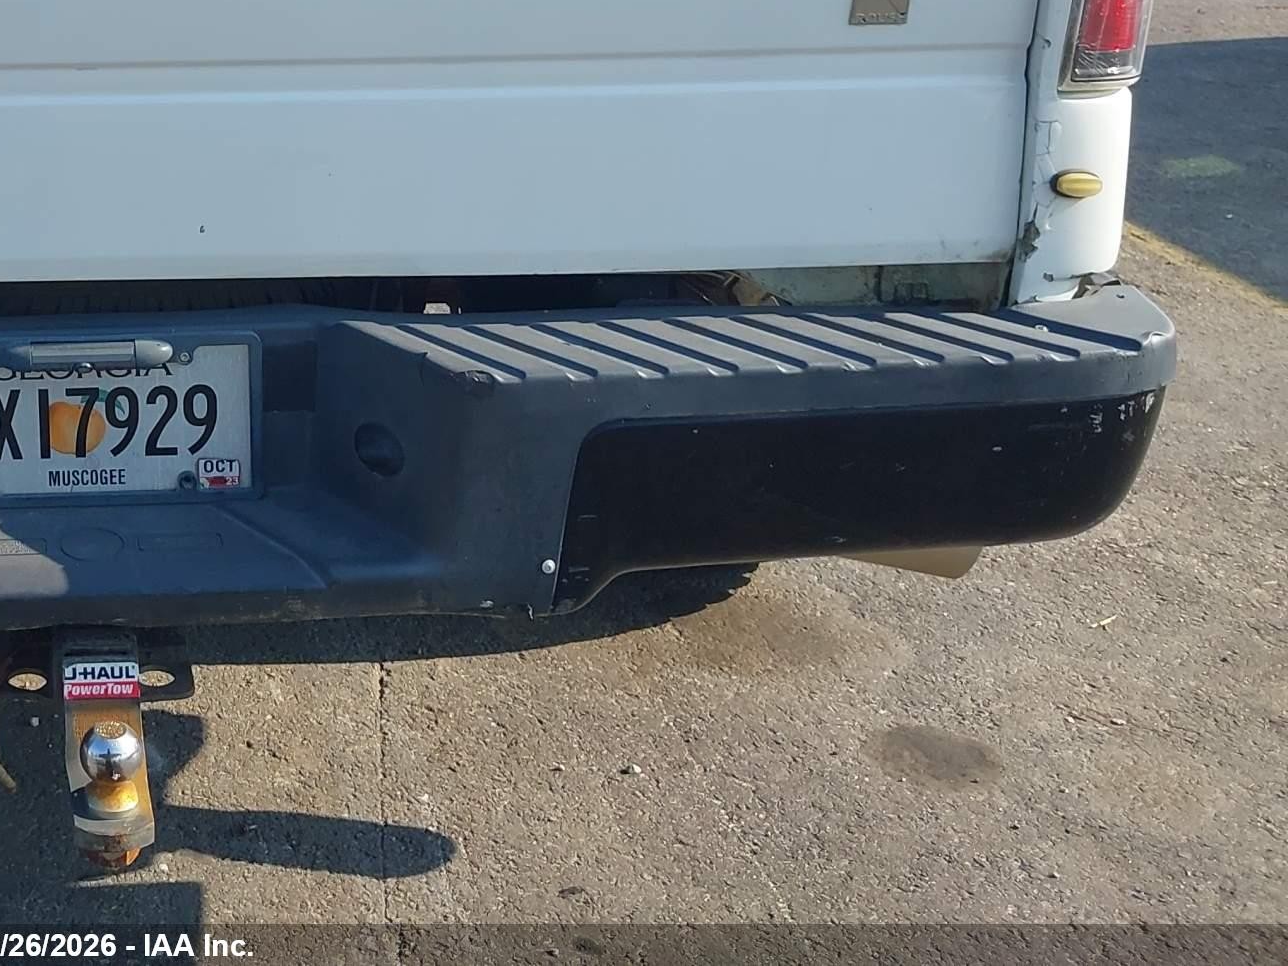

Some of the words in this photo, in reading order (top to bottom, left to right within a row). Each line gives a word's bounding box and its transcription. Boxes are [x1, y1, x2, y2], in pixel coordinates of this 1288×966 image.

[203, 459, 237, 473] OCT
[48, 469, 127, 487] MUSCOGEE
[64, 683, 134, 697] PowerTow
